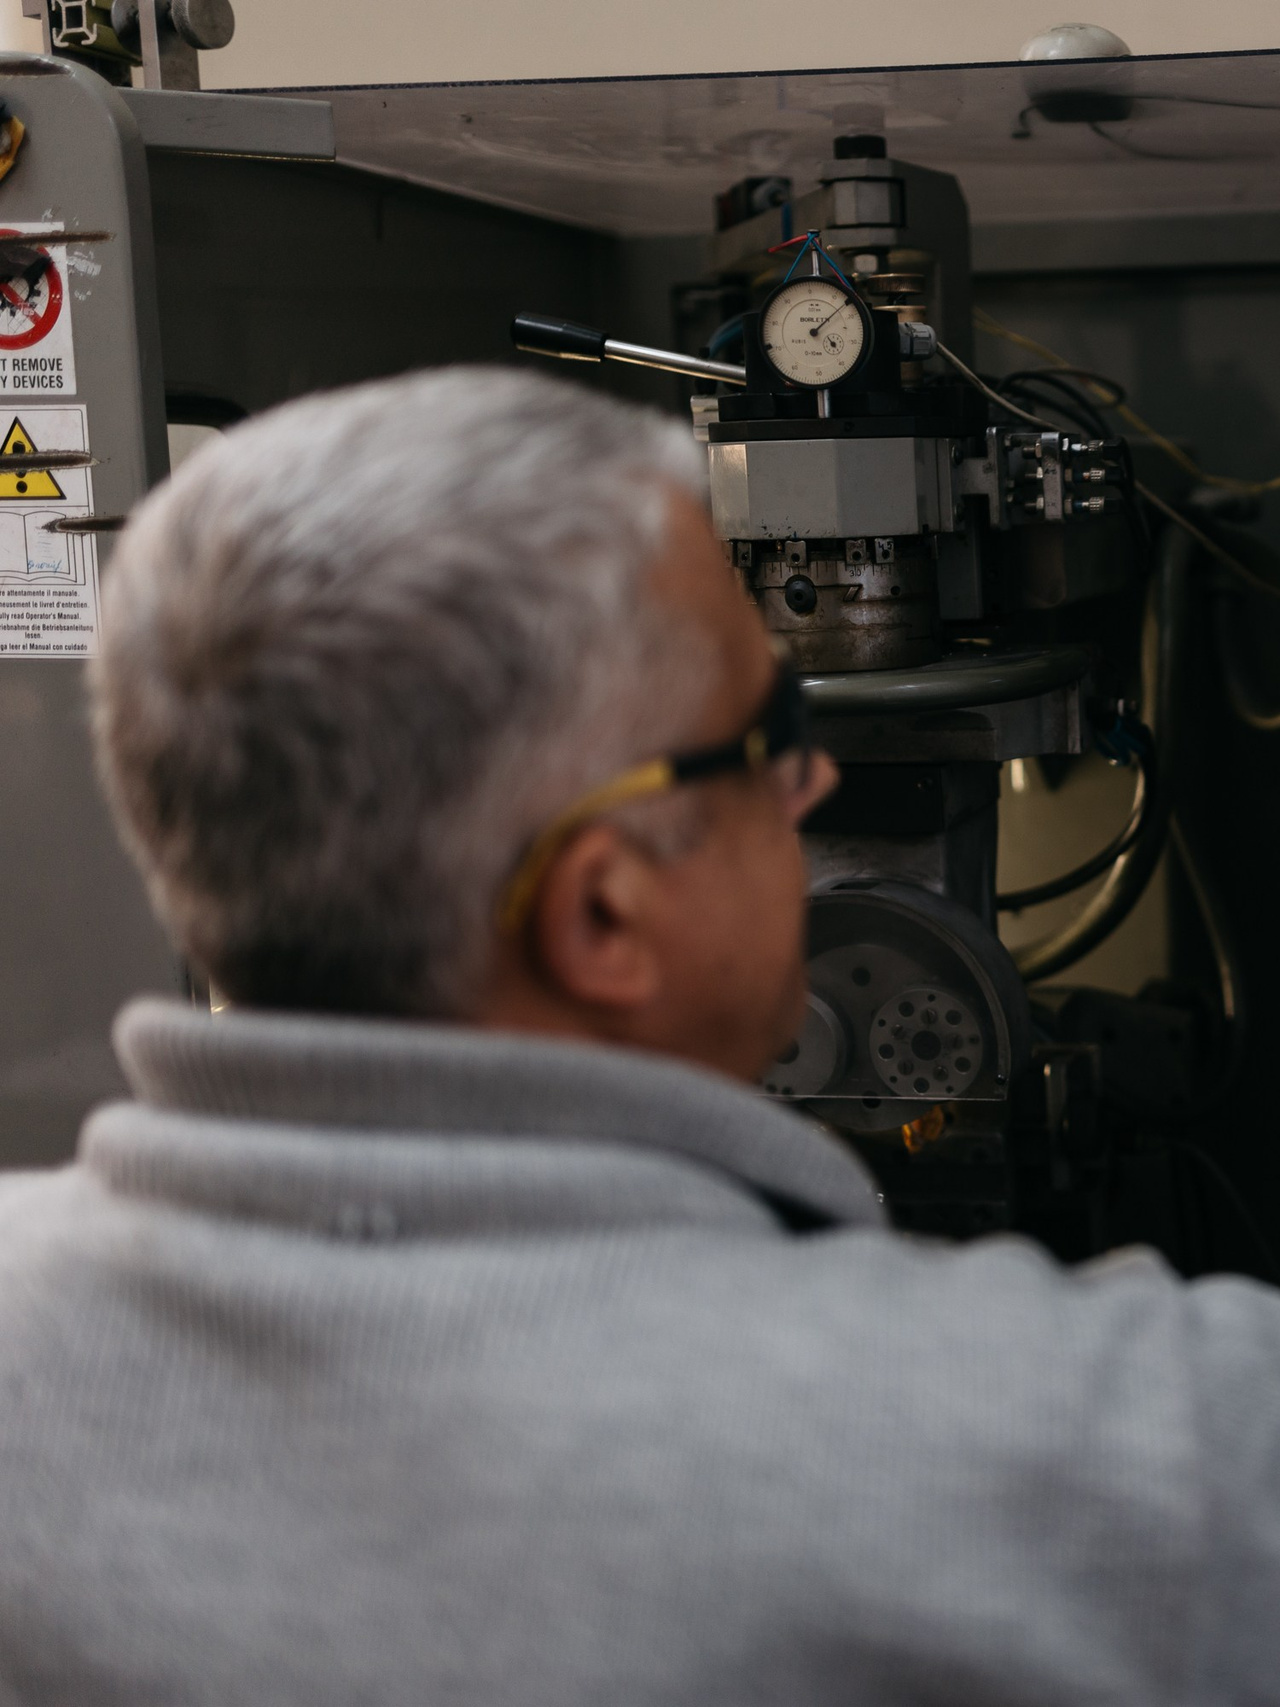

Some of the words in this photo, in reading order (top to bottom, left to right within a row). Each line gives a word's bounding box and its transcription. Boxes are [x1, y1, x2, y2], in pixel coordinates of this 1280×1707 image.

[12, 358, 63, 371] REMOVE
[13, 375, 64, 389] DEVICES
[11, 612, 24, 620] read
[25, 612, 56, 621] Operator's
[42, 624, 94, 633] Betriebsanleitung
